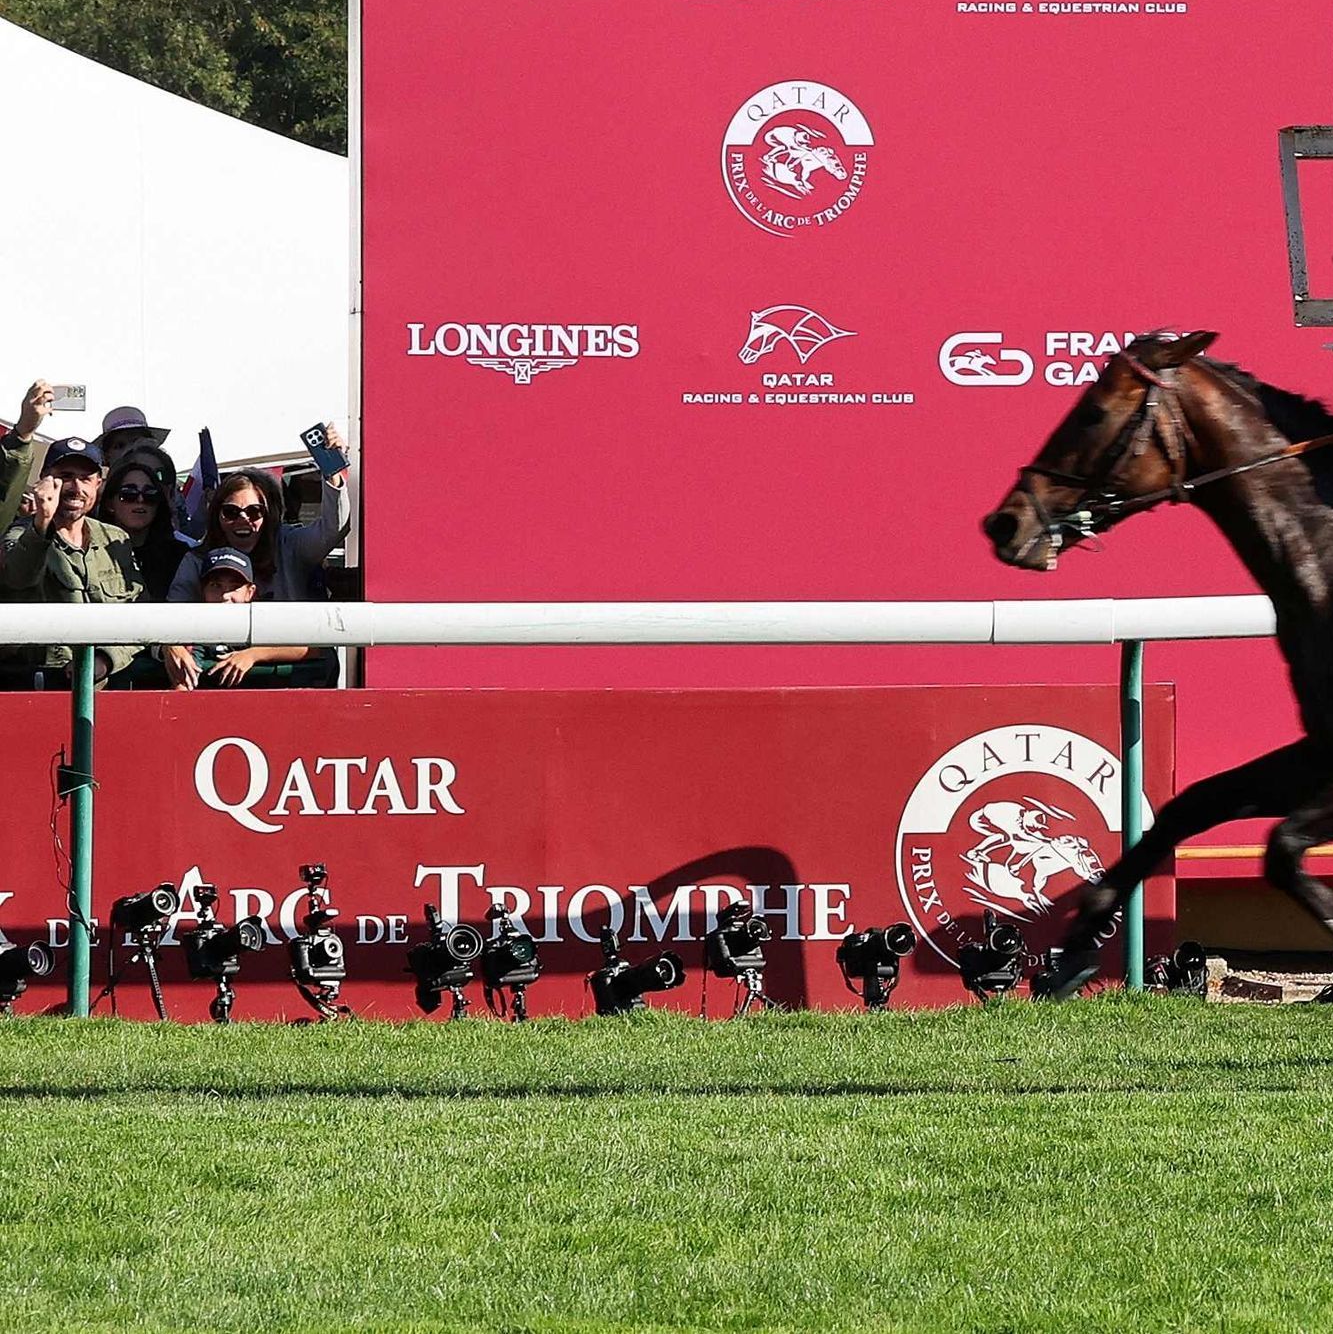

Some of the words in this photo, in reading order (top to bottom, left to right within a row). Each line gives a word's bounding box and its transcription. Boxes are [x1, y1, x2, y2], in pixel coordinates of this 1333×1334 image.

[957, 2, 1015, 13] RACING
[1021, 2, 1033, 13] &
[1038, 2, 1140, 15] EQUESTRIAN
[1144, 3, 1187, 13] CLUB
[747, 86, 850, 123] QATAR
[731, 152, 750, 193] PRIX
[745, 191, 759, 206] DE
[797, 217, 812, 226] DE
[812, 152, 867, 226] TRIOMPHE
[407, 322, 640, 358] LONGINES
[682, 393, 741, 404] RACING
[748, 393, 760, 404] &
[764, 393, 866, 405] EQUESTRIAN
[871, 393, 914, 404] CLUB
[762, 373, 834, 389] QATAR
[194, 736, 465, 834] QATAR
[938, 733, 1115, 794] QATAR
[356, 915, 409, 944] DE
[414, 863, 855, 943] TRIOMPHE
[911, 847, 943, 914] PRIX
